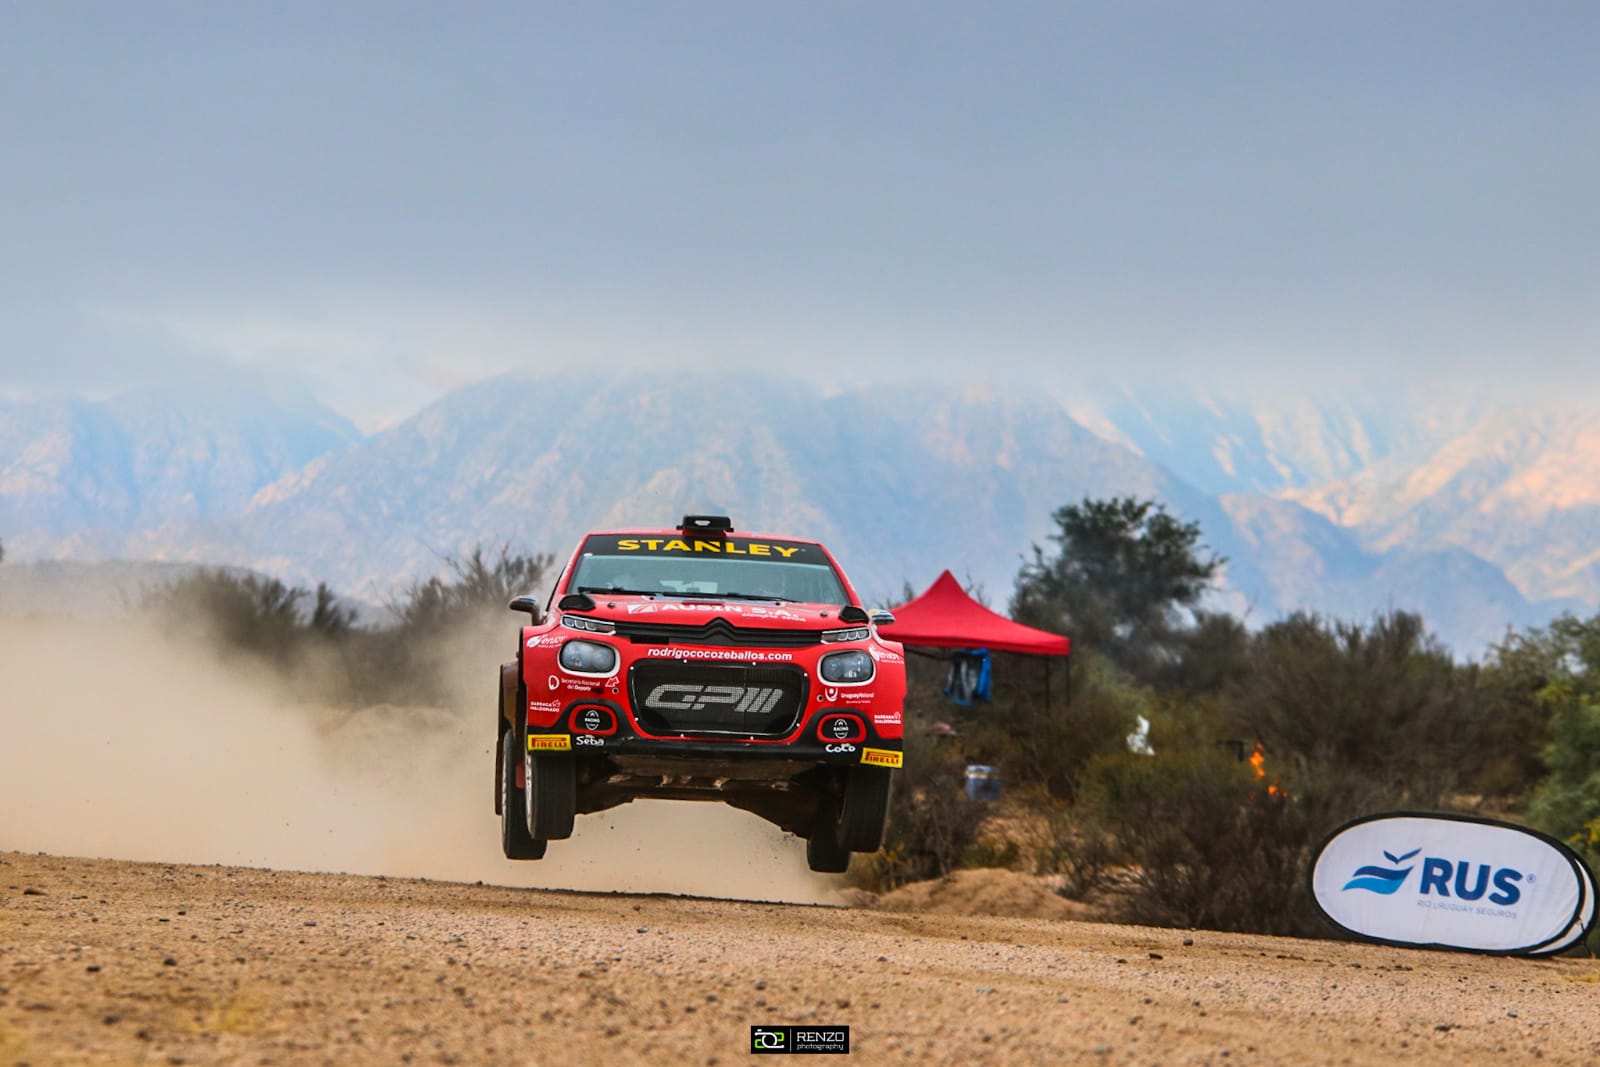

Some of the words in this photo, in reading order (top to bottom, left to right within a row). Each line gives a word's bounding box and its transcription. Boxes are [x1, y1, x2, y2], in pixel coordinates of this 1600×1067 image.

[617, 539, 800, 558] STANLEY
[647, 647, 793, 660] rodrigococozeballos.com
[531, 737, 567, 748] PIRELLI
[576, 735, 604, 747] Seba
[865, 751, 899, 764] PIRELLI
[1419, 857, 1523, 906] RUS
[1432, 902, 1473, 913] URUGUAY
[1475, 906, 1517, 919] SEGUROS
